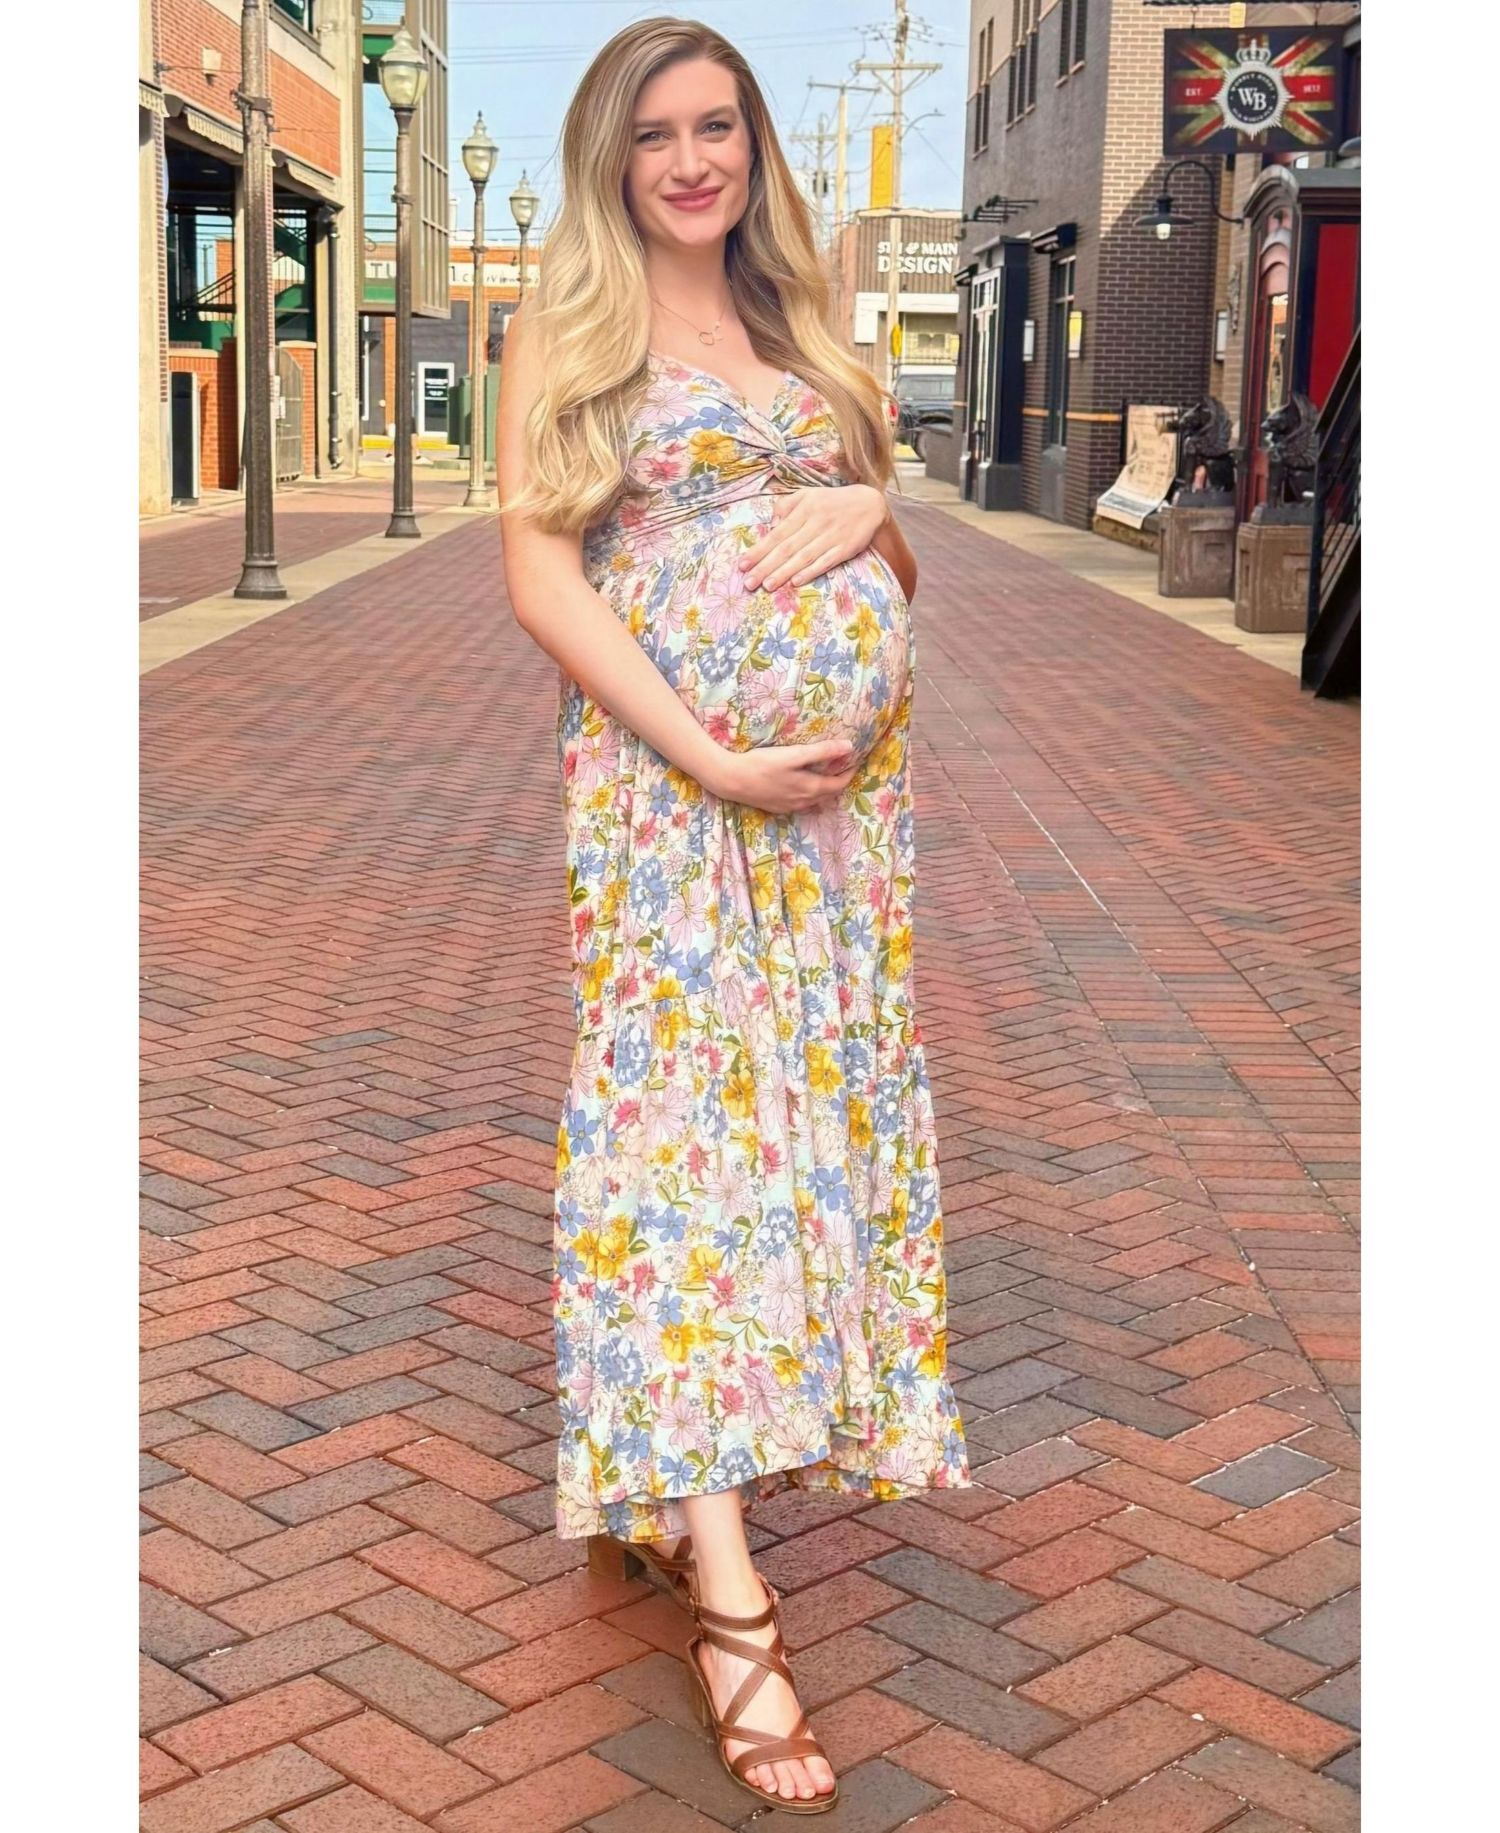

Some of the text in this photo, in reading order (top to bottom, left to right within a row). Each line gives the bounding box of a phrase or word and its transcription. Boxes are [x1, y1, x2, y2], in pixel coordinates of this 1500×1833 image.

[1238, 87, 1267, 111] WB
[921, 242, 958, 255] MAIN
[877, 256, 954, 274] DESIGN
